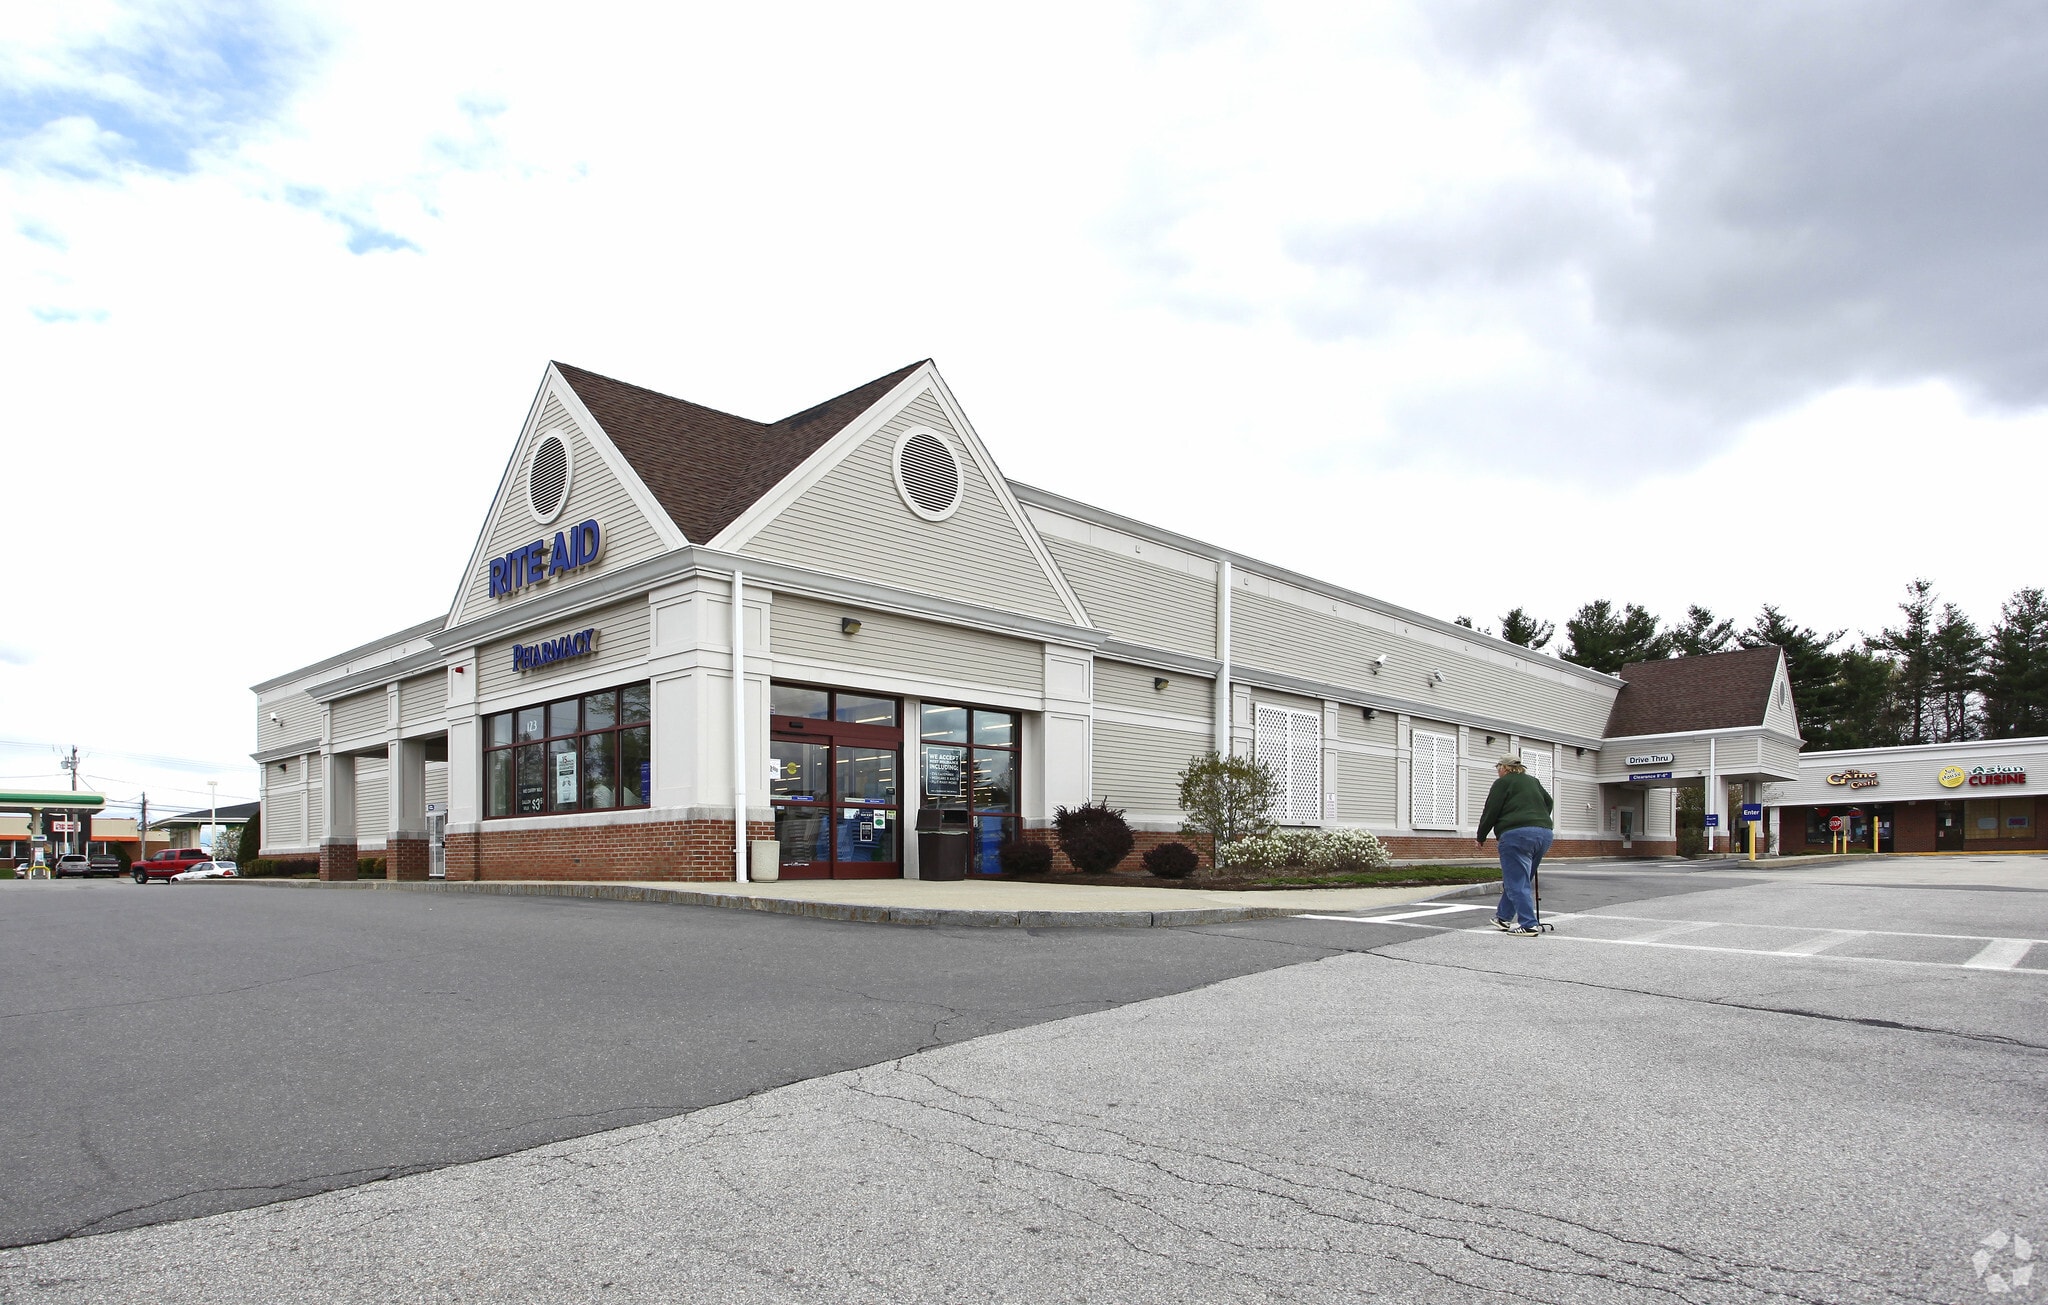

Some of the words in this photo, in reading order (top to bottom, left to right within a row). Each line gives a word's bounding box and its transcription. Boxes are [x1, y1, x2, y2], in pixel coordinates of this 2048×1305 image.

[489, 539, 544, 599] RITE
[548, 518, 601, 577] AID
[512, 628, 595, 672] PHARMACY
[526, 719, 538, 733] 123
[1969, 765, 2025, 775] Asian
[1826, 771, 1878, 785] Game
[1850, 779, 1880, 789] Castle
[1968, 774, 2026, 787] CUISINE
